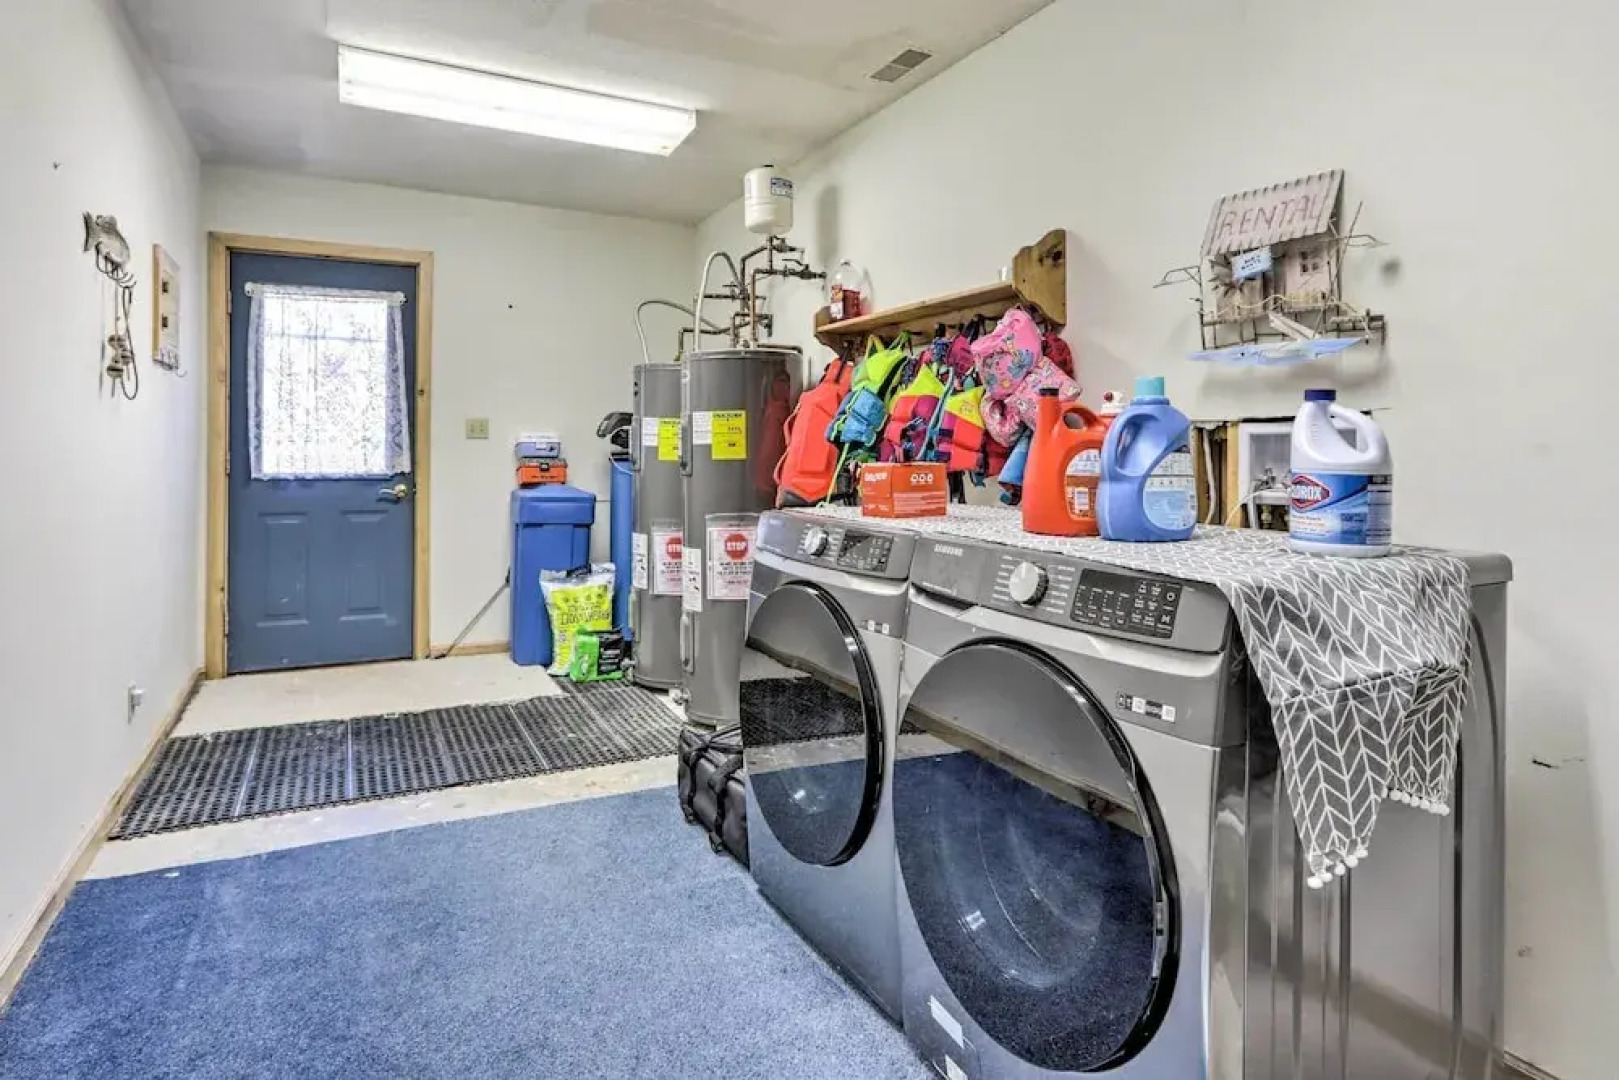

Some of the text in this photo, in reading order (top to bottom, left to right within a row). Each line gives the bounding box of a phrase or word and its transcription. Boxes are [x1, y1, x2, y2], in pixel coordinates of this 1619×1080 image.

[1219, 194, 1320, 237] RENTAL
[725, 541, 747, 552] STOP
[933, 543, 964, 557] SAMSUNG
